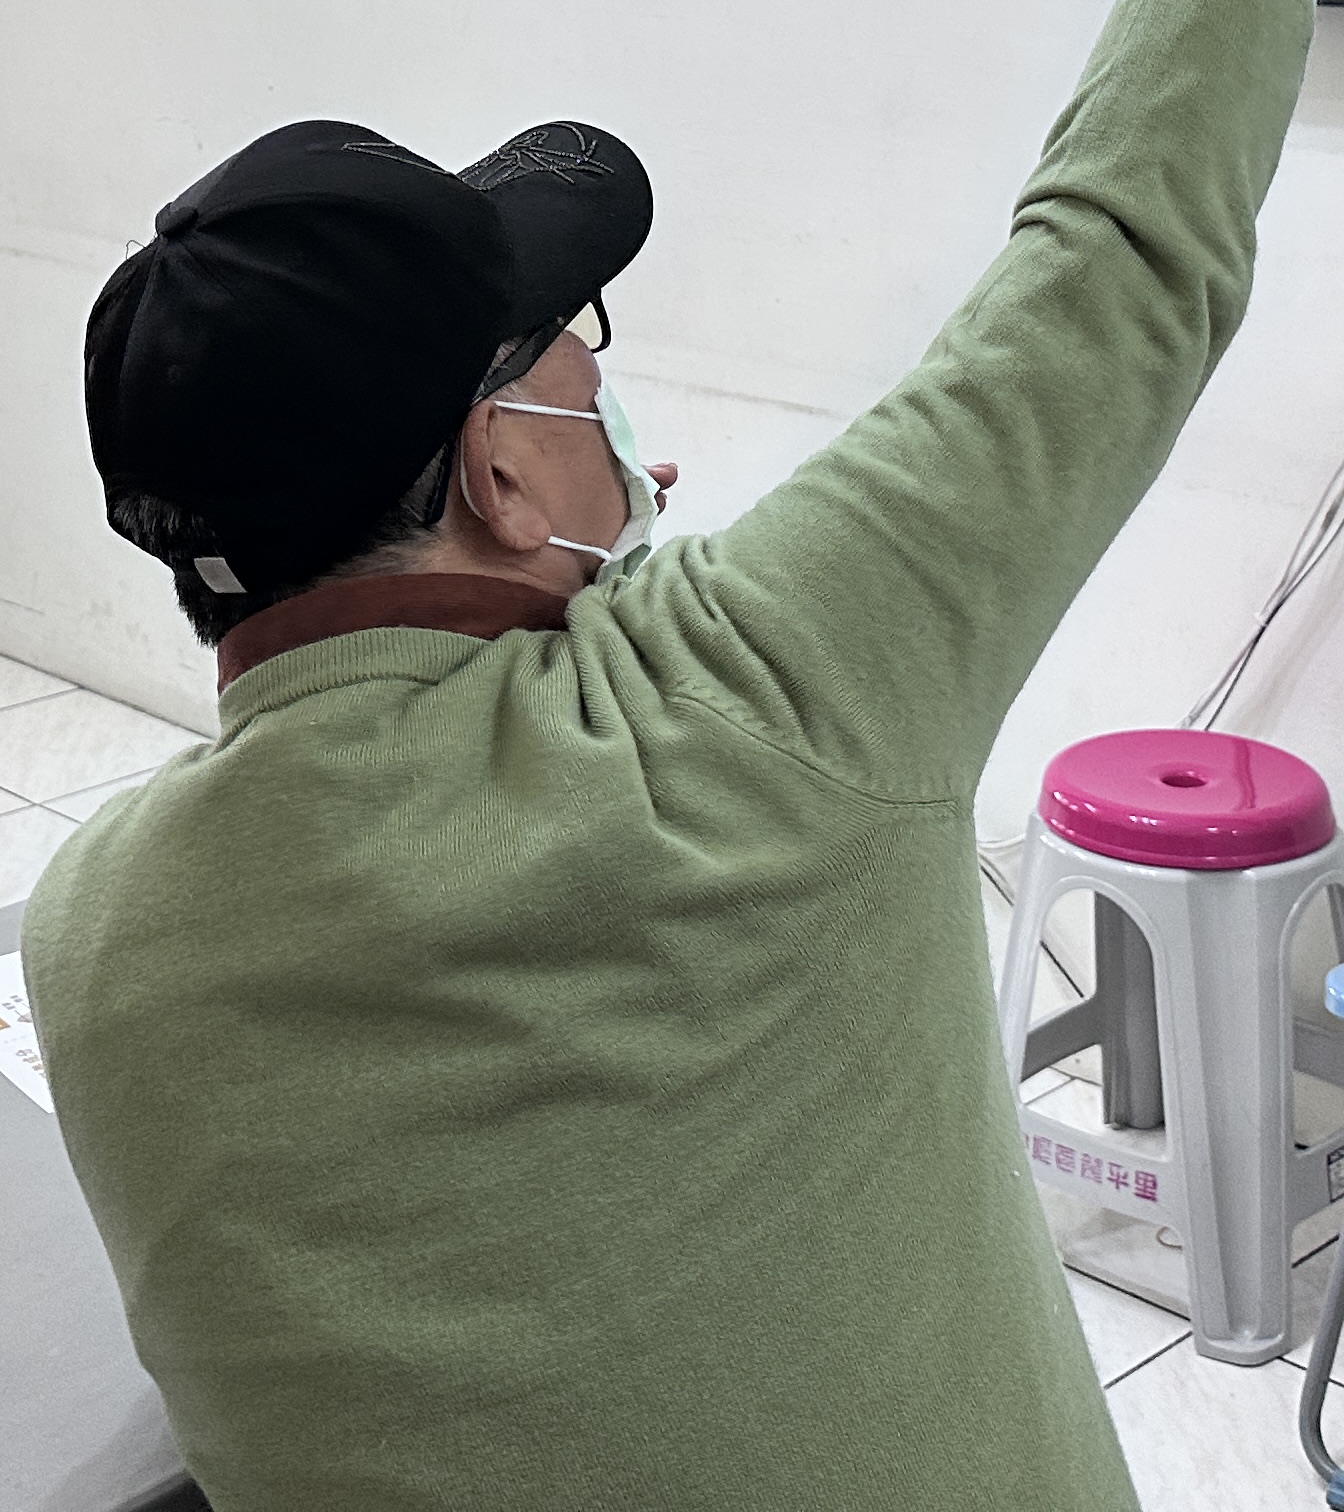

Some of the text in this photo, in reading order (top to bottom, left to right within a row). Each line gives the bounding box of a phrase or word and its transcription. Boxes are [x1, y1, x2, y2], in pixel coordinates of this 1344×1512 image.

[1025, 1133, 1159, 1202] 壢區龍平里
